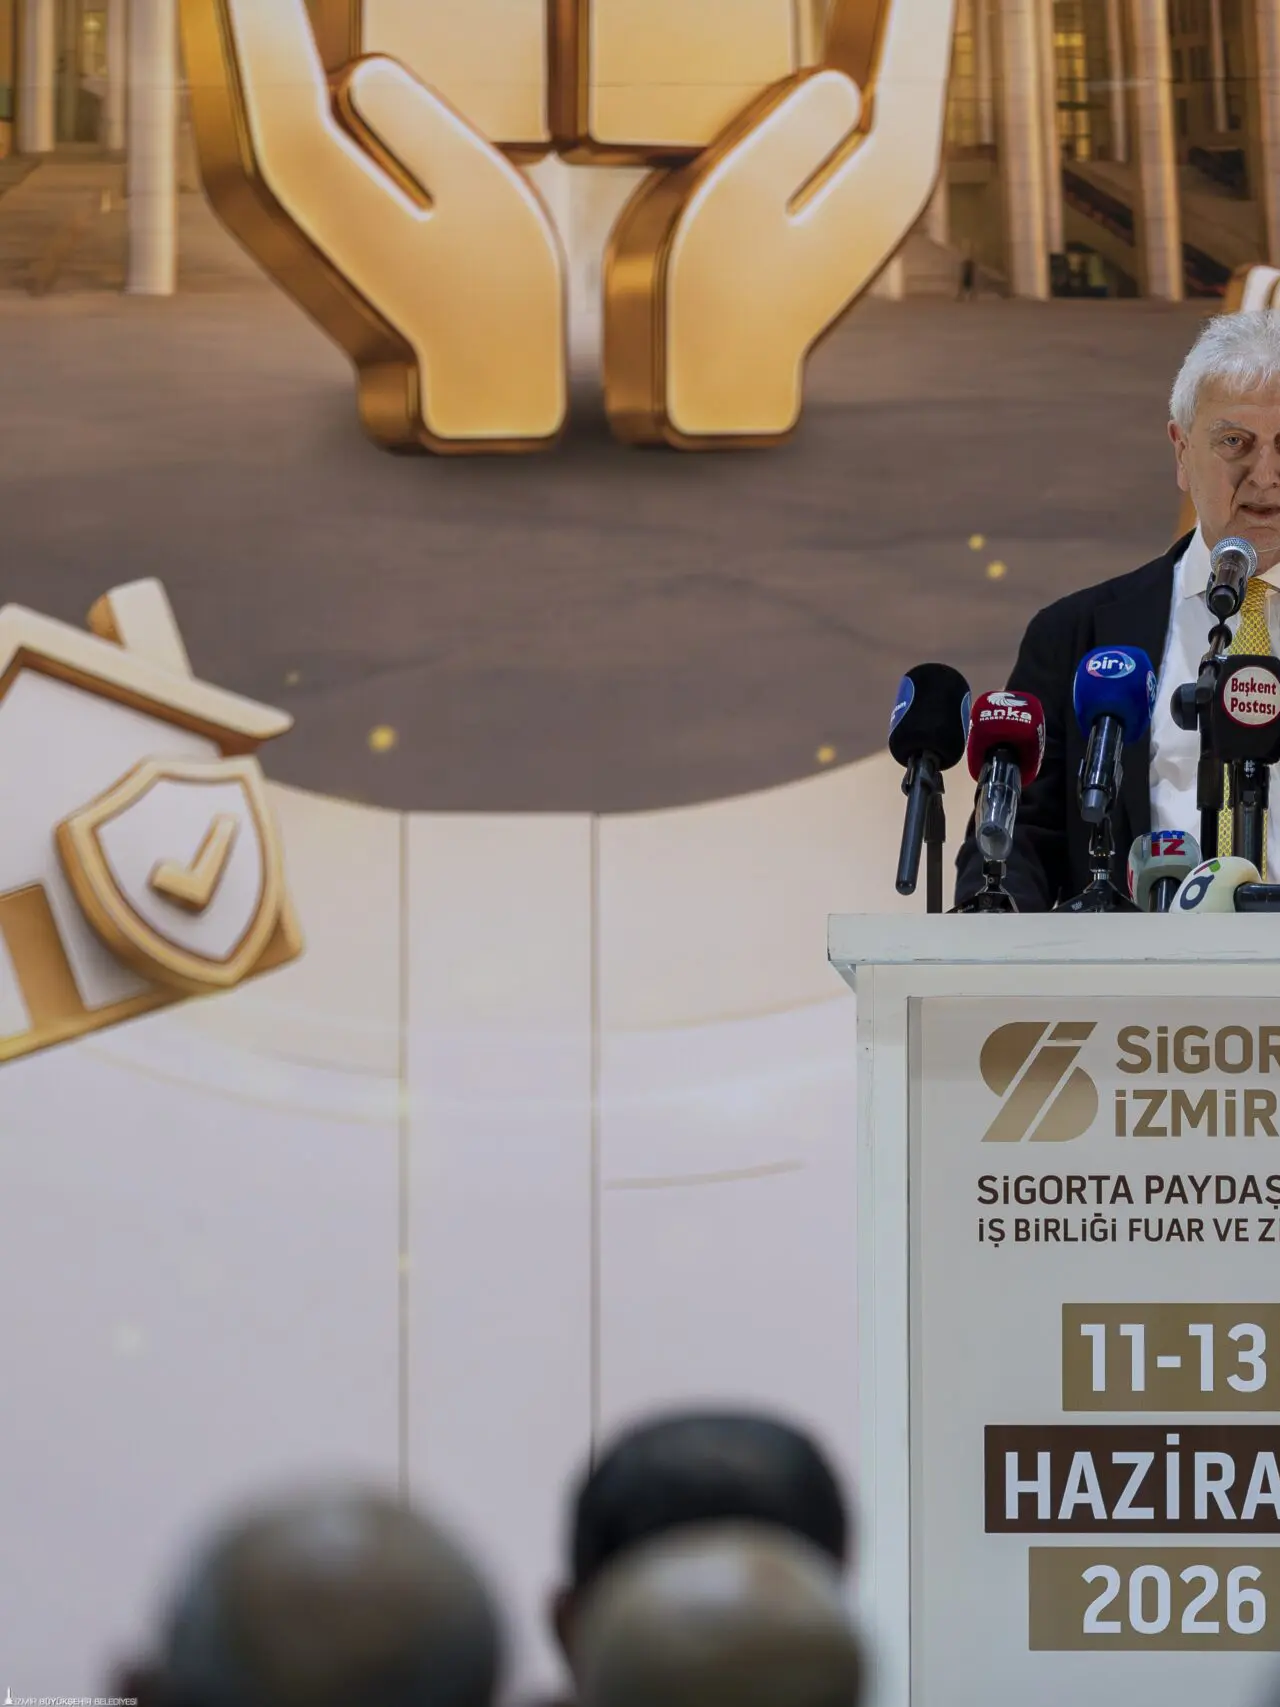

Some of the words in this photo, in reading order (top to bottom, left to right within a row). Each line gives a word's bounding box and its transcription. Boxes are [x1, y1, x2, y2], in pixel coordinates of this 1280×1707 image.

[1231, 677, 1277, 697] Başkent
[980, 706, 1032, 721] anka
[1230, 697, 1276, 716] Postası
[1128, 1217, 1205, 1243] FUAR
[1212, 1217, 1250, 1243] VE
[1080, 1322, 1267, 1393] 11-13
[1080, 1564, 1267, 1635] 2026
